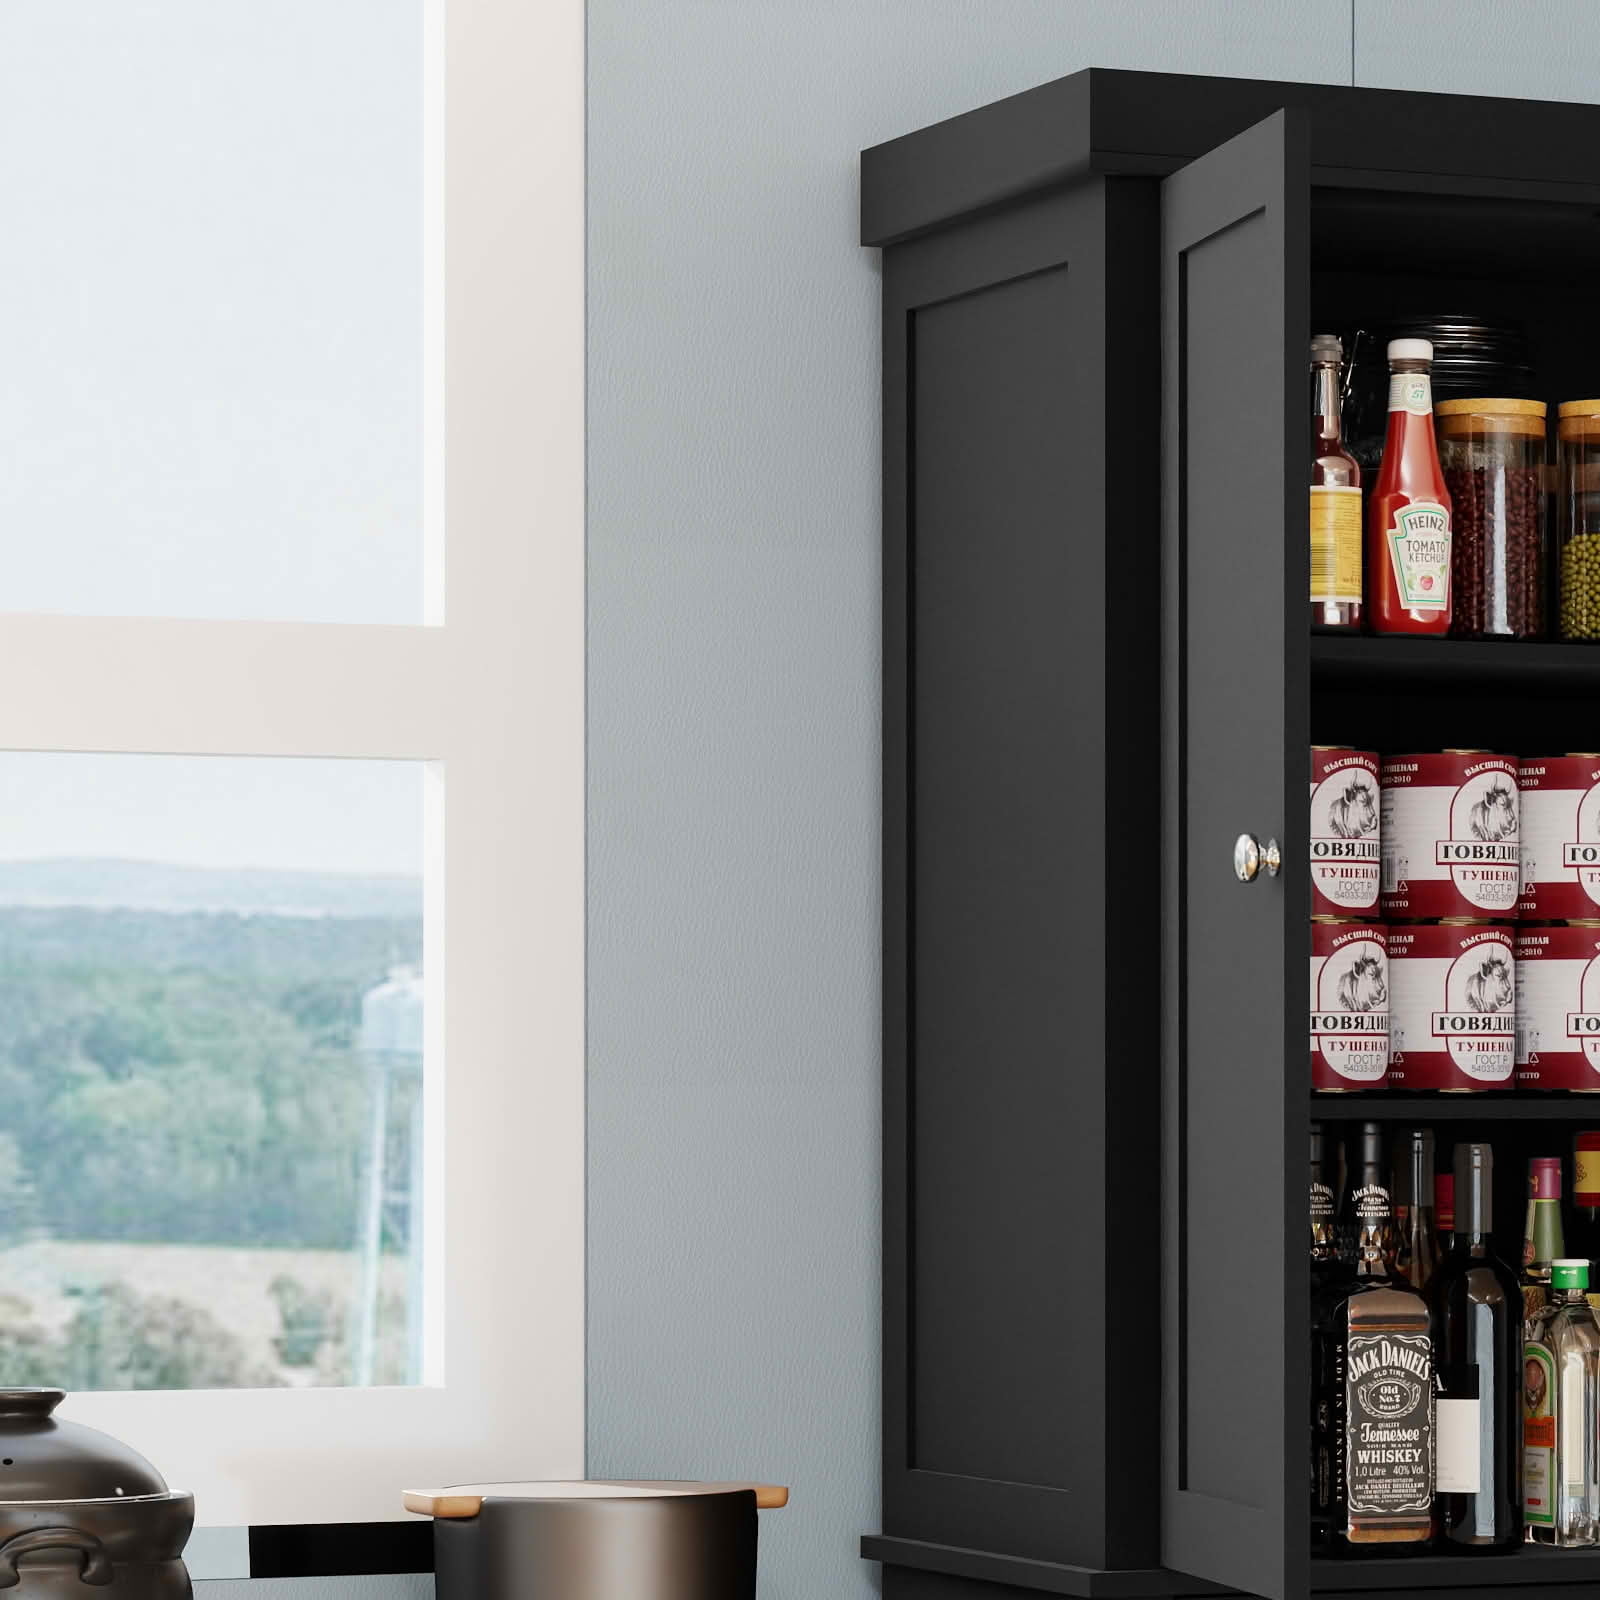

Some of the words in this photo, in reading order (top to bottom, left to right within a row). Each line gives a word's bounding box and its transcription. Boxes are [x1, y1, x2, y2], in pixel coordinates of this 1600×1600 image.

[1408, 515, 1445, 532] HEINZ
[1406, 540, 1446, 552] TOMATO
[1323, 756, 1364, 773] ВЫСШИЙ
[1464, 760, 1504, 777] ВЫСШИЙ
[1332, 930, 1372, 947] ВЫСШИЙ
[1460, 931, 1499, 948] ВЫСШИЙ
[1348, 1348, 1380, 1382] JACK
[1374, 1370, 1388, 1378] OLD
[1389, 1369, 1405, 1377] TIME
[1380, 1386, 1398, 1394] Old
[1360, 1422, 1420, 1442] Tennessee
[1357, 1449, 1422, 1464] WHISKEY
[1355, 1466, 1368, 1477] 1.0
[1369, 1466, 1386, 1476] Litre
[1393, 1465, 1410, 1475] 40%
